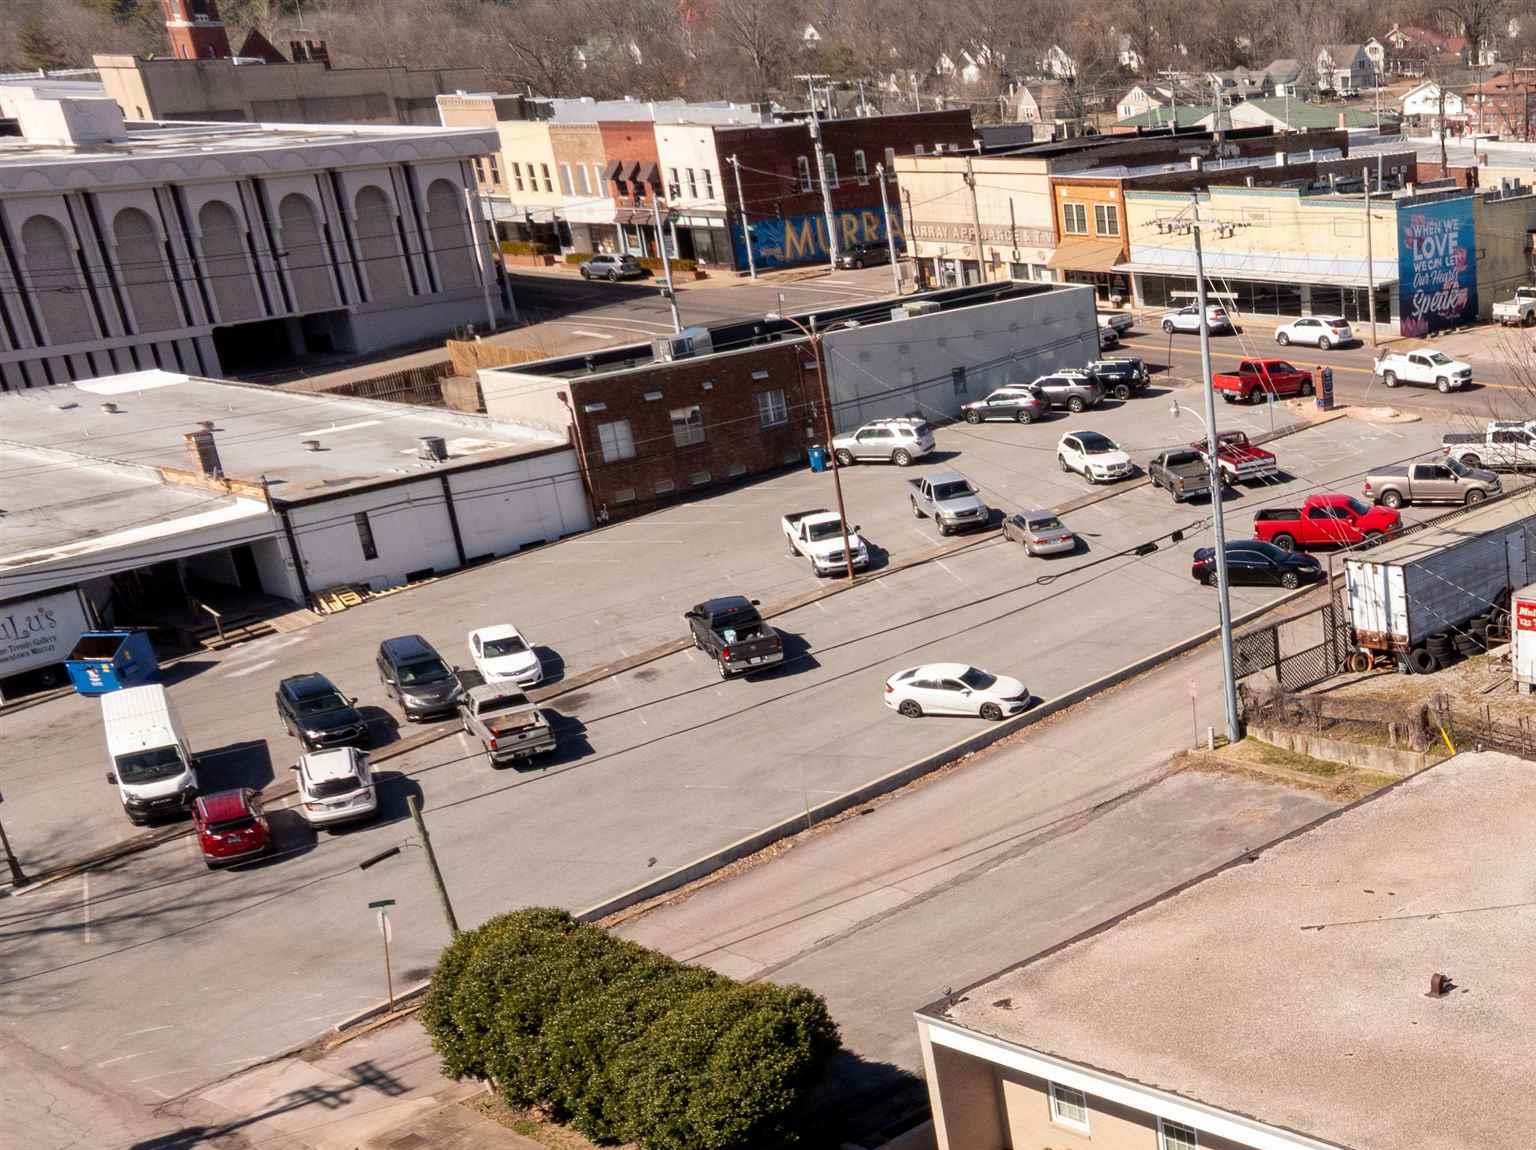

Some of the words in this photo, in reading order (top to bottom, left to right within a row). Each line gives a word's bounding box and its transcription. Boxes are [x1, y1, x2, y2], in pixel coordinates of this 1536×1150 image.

[953, 226, 1020, 242] APPIANCE
[1413, 222, 1441, 237] WHEN
[1444, 219, 1459, 233] WE
[1413, 232, 1458, 261] LOVE
[1413, 261, 1428, 273] WE
[1428, 259, 1442, 270] CAN
[1445, 255, 1458, 267] LET
[1413, 272, 1429, 289] Our
[1411, 285, 1458, 320] Speak
